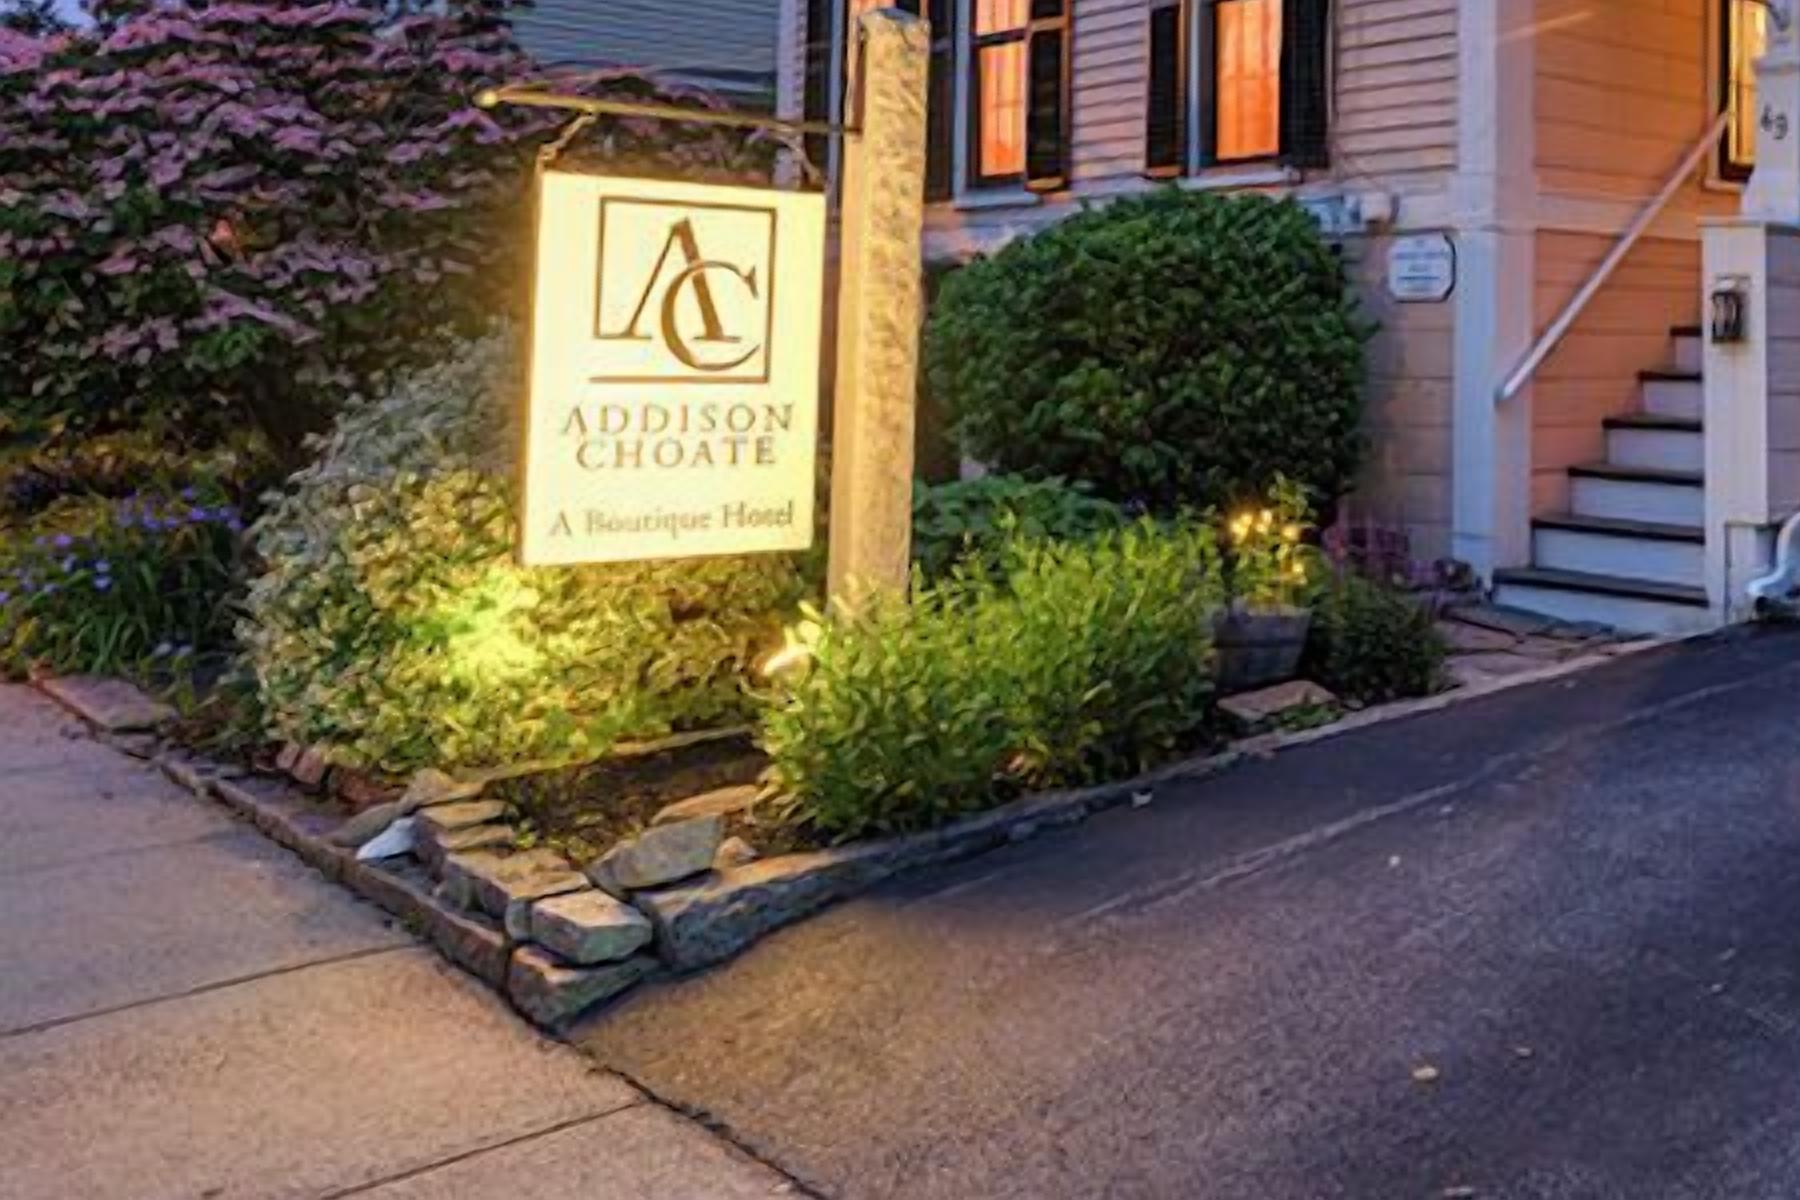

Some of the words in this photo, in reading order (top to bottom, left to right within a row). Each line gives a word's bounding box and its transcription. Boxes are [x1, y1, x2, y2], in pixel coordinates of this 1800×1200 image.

[562, 403, 794, 436] ADDISON
[575, 435, 777, 470] CHOATE
[549, 509, 573, 537] A
[585, 505, 713, 540] Boutique
[721, 499, 794, 529] Hotel
